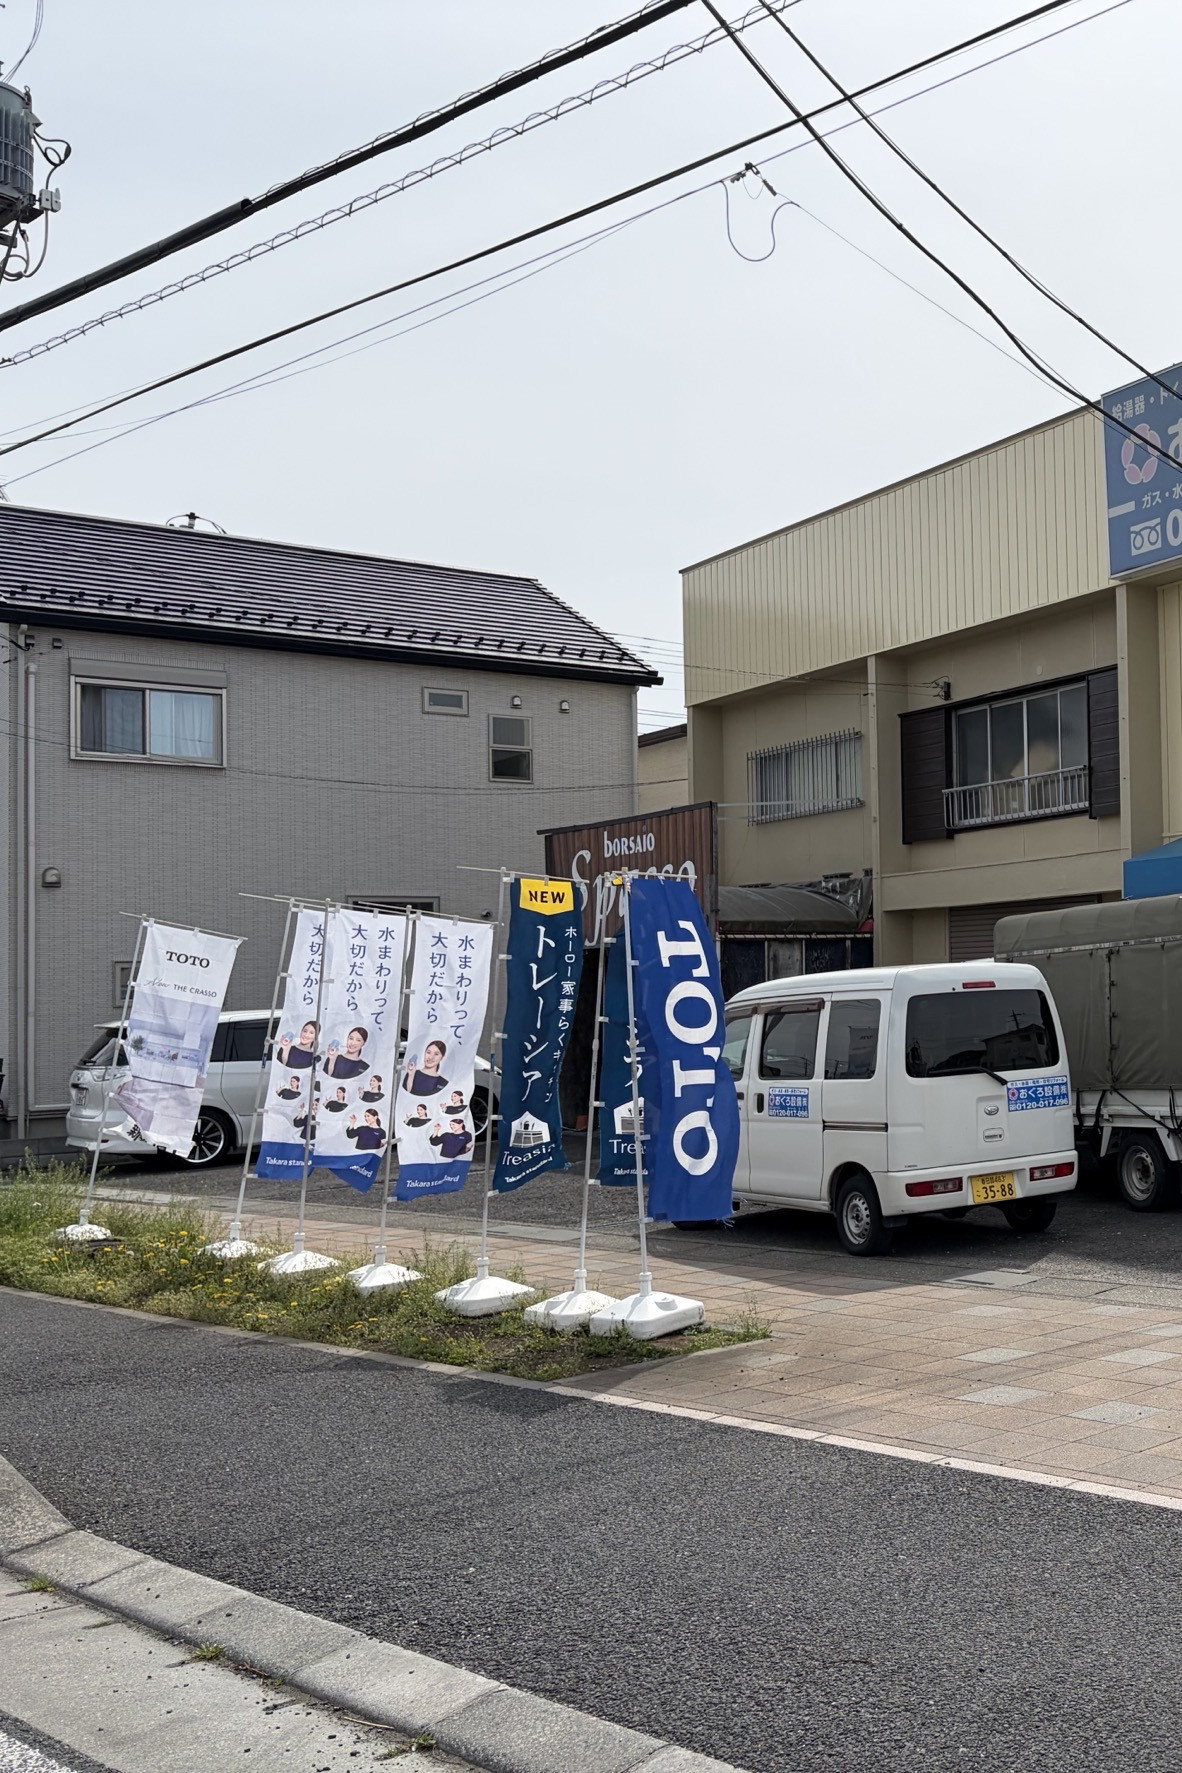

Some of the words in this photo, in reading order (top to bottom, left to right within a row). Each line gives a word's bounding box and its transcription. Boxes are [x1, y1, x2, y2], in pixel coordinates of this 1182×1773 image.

[529, 890, 566, 904] NEW
[166, 951, 210, 968] TOTO
[346, 924, 368, 1011] 大切だから
[371, 927, 395, 1031] 水まわりって、
[427, 932, 448, 1023] 大切だから
[173, 984, 187, 992] THE
[190, 987, 217, 998] CRASSO
[450, 935, 475, 1045] 水まわりって、
[522, 925, 557, 1102] トレーシア
[657, 920, 720, 1176] TOTO
[1016, 1098, 1068, 1110] 0120-017-096
[265, 1157, 287, 1166] Takara
[406, 1180, 430, 1188] Takara
[982, 1183, 1014, 1199] 35-88
